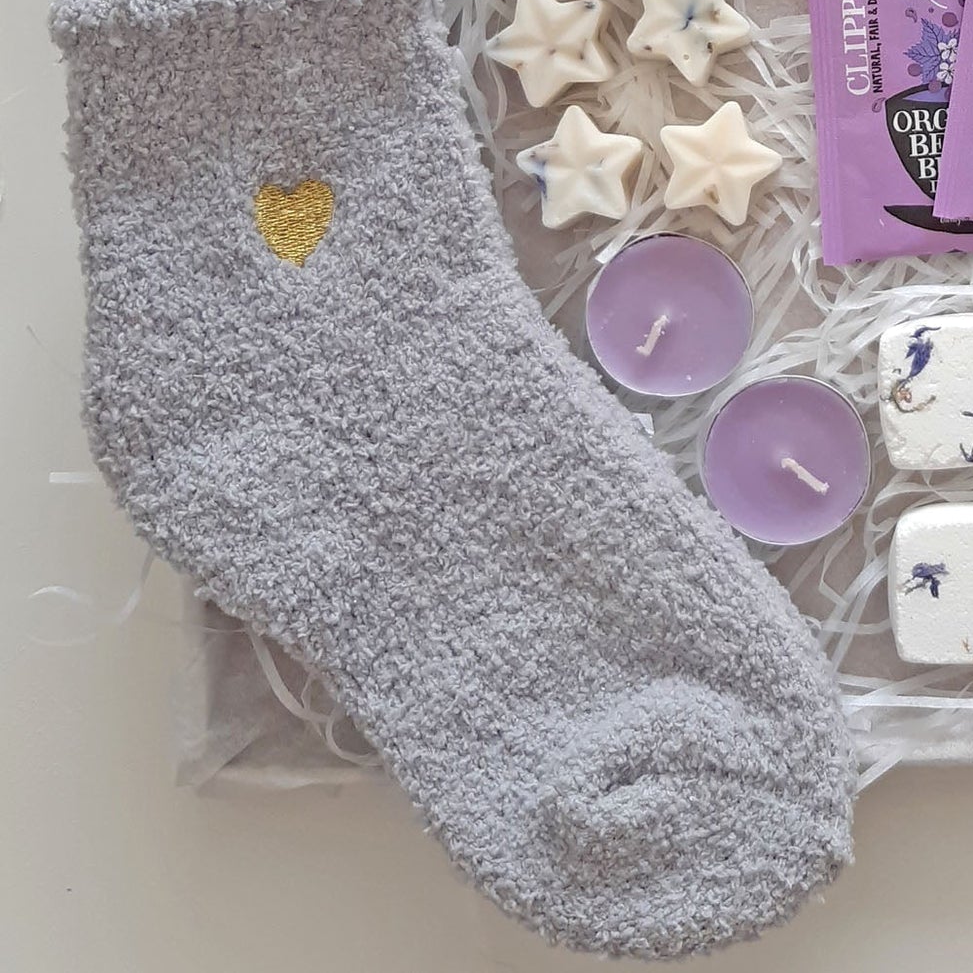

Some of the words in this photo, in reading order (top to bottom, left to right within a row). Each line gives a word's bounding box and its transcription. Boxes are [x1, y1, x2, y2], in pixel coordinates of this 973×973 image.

[868, 7, 878, 15] &
[868, 18, 879, 41] FAIR
[870, 43, 884, 93] NATURAL,
